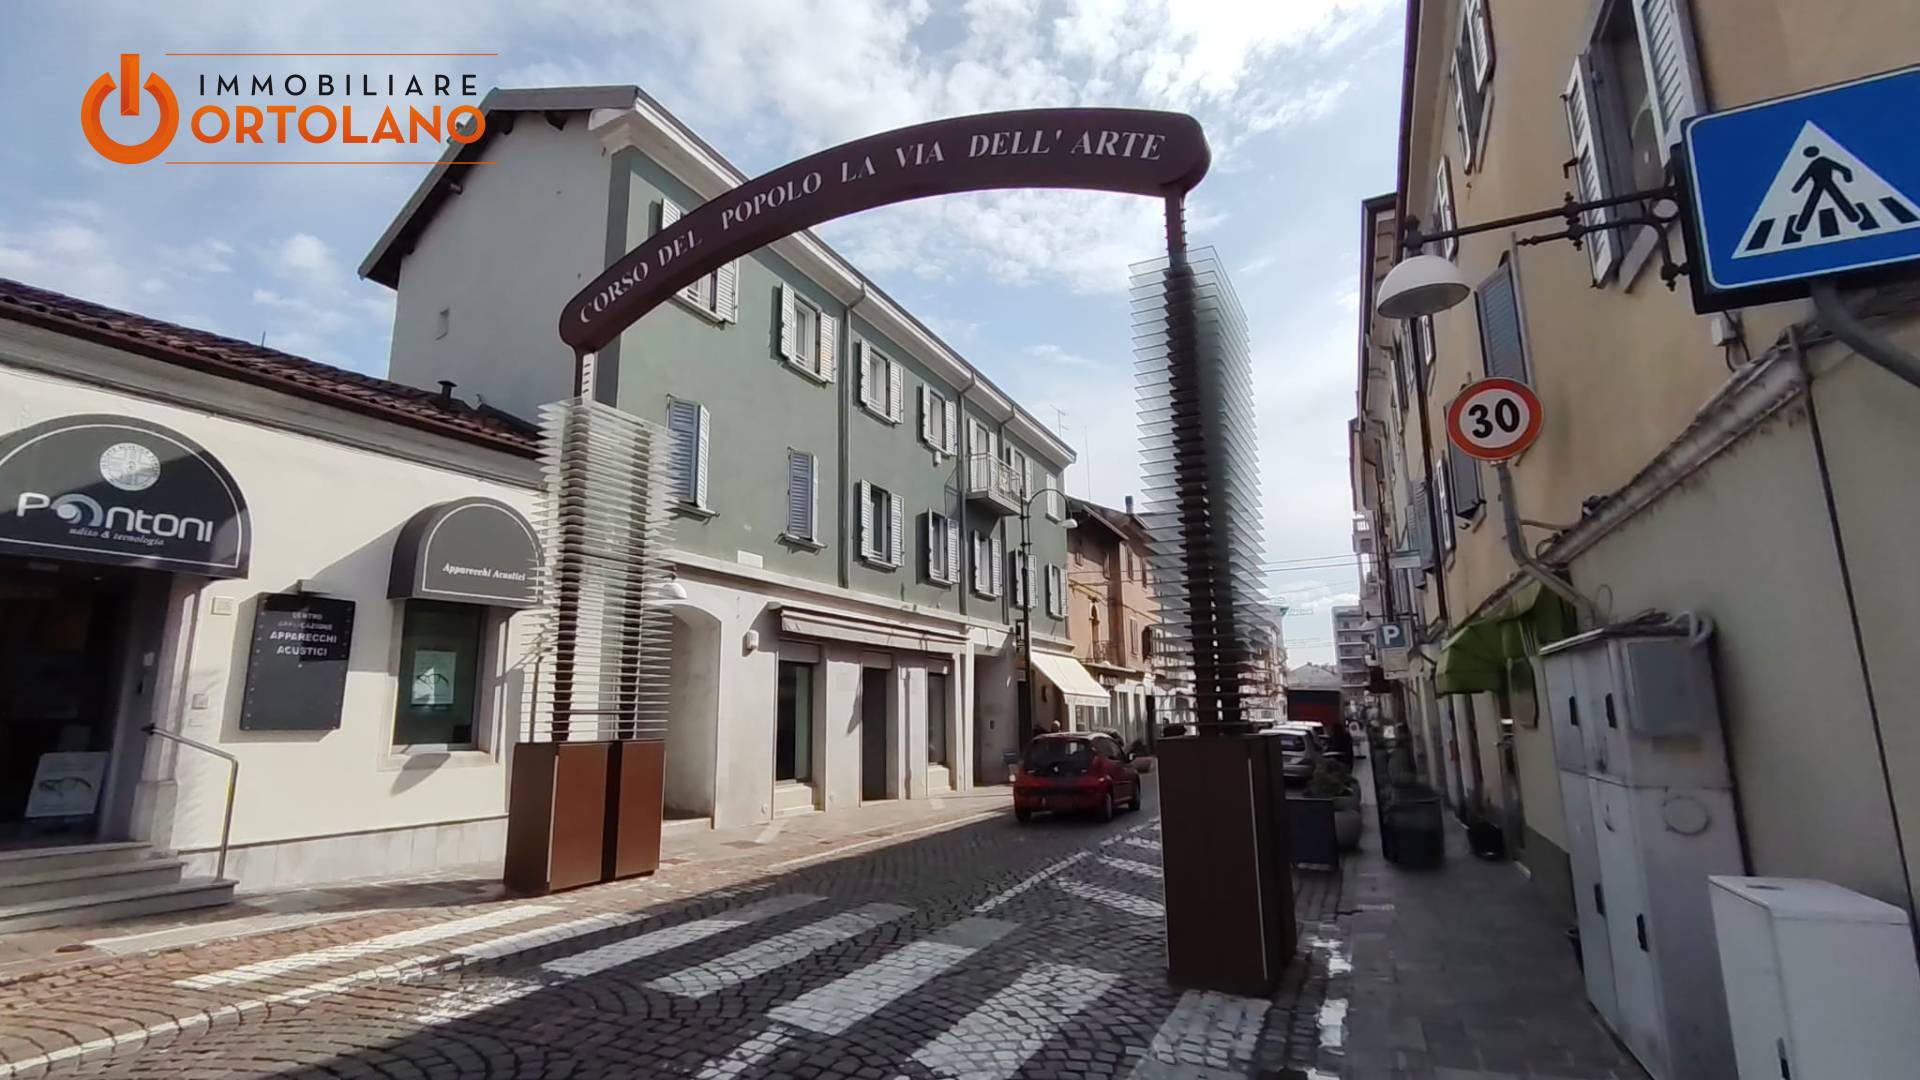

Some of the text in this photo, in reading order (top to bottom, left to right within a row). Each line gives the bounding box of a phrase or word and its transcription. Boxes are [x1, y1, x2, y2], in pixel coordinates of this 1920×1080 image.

[579, 129, 1166, 324] CORSO DEL POPOLO LA VIA DELL' ARTE
[1468, 397, 1520, 439] 30
[442, 563, 491, 576] Apparecchi
[269, 631, 337, 643] APPARECCHI
[1381, 625, 1400, 645] P
[276, 645, 328, 656] ACUSTICI
